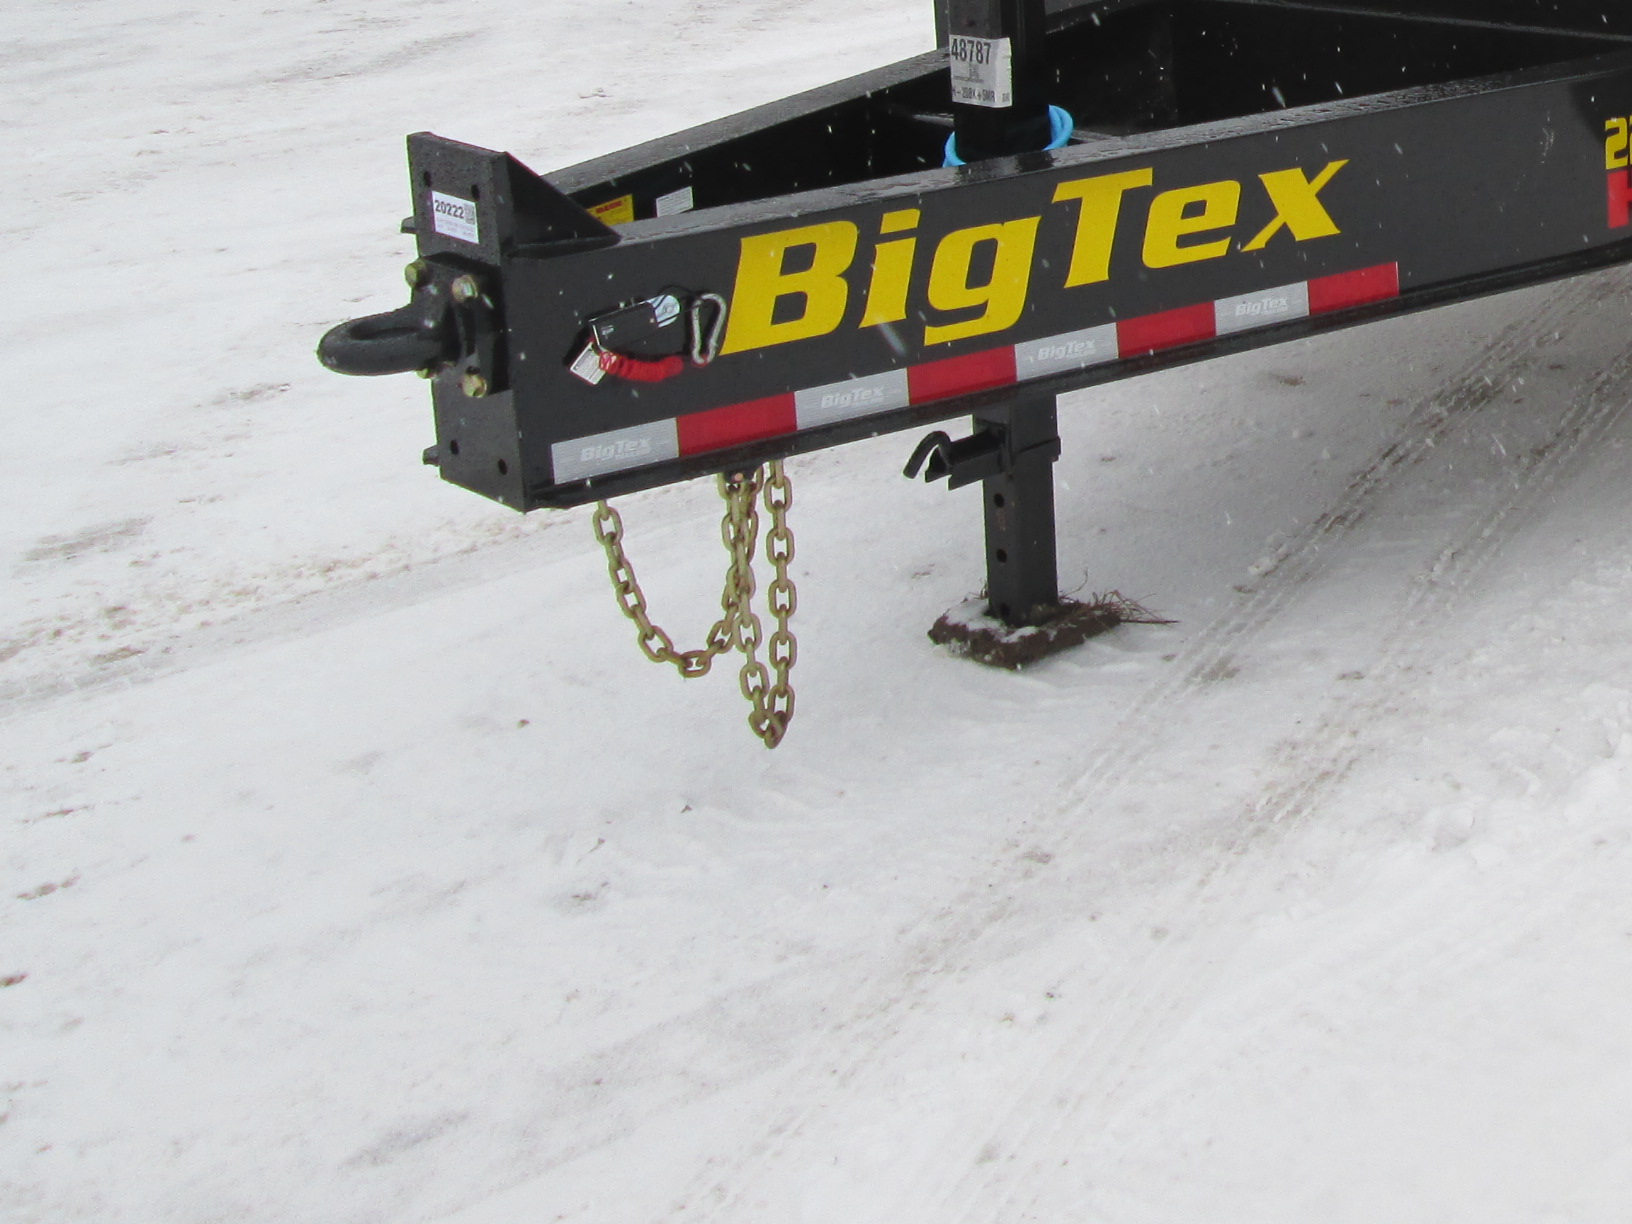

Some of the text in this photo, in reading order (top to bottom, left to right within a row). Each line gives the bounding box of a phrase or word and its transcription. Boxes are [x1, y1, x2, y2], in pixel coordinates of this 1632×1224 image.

[951, 38, 991, 65] 48787
[434, 199, 465, 219] 20222
[720, 159, 1349, 355] BigTex
[1235, 297, 1289, 318] BigTex
[1037, 339, 1097, 362] BigTex
[820, 385, 885, 410] BigTex
[579, 437, 653, 463] BigTex
